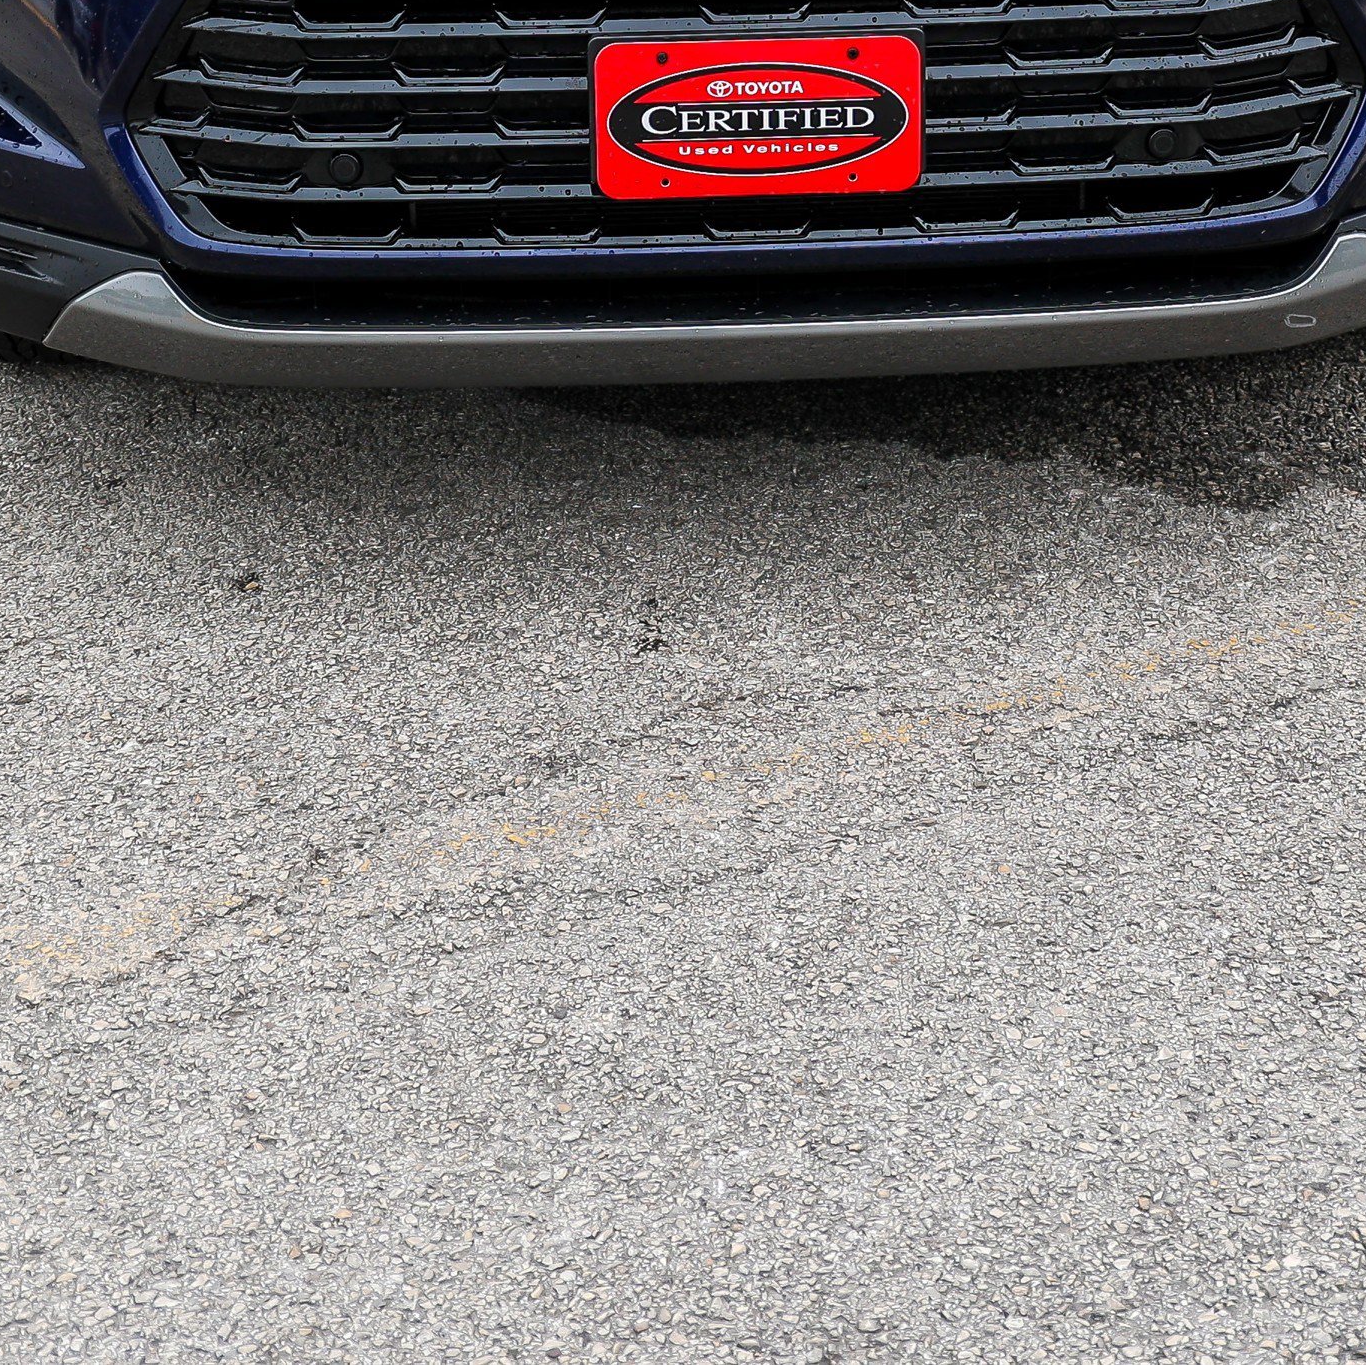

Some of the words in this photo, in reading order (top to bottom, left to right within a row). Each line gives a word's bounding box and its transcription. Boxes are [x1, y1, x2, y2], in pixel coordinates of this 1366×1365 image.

[735, 80, 804, 96] TOYOTA
[641, 105, 875, 136] CERTIFIED
[678, 143, 734, 156] Used
[743, 142, 839, 154] Vehicles
